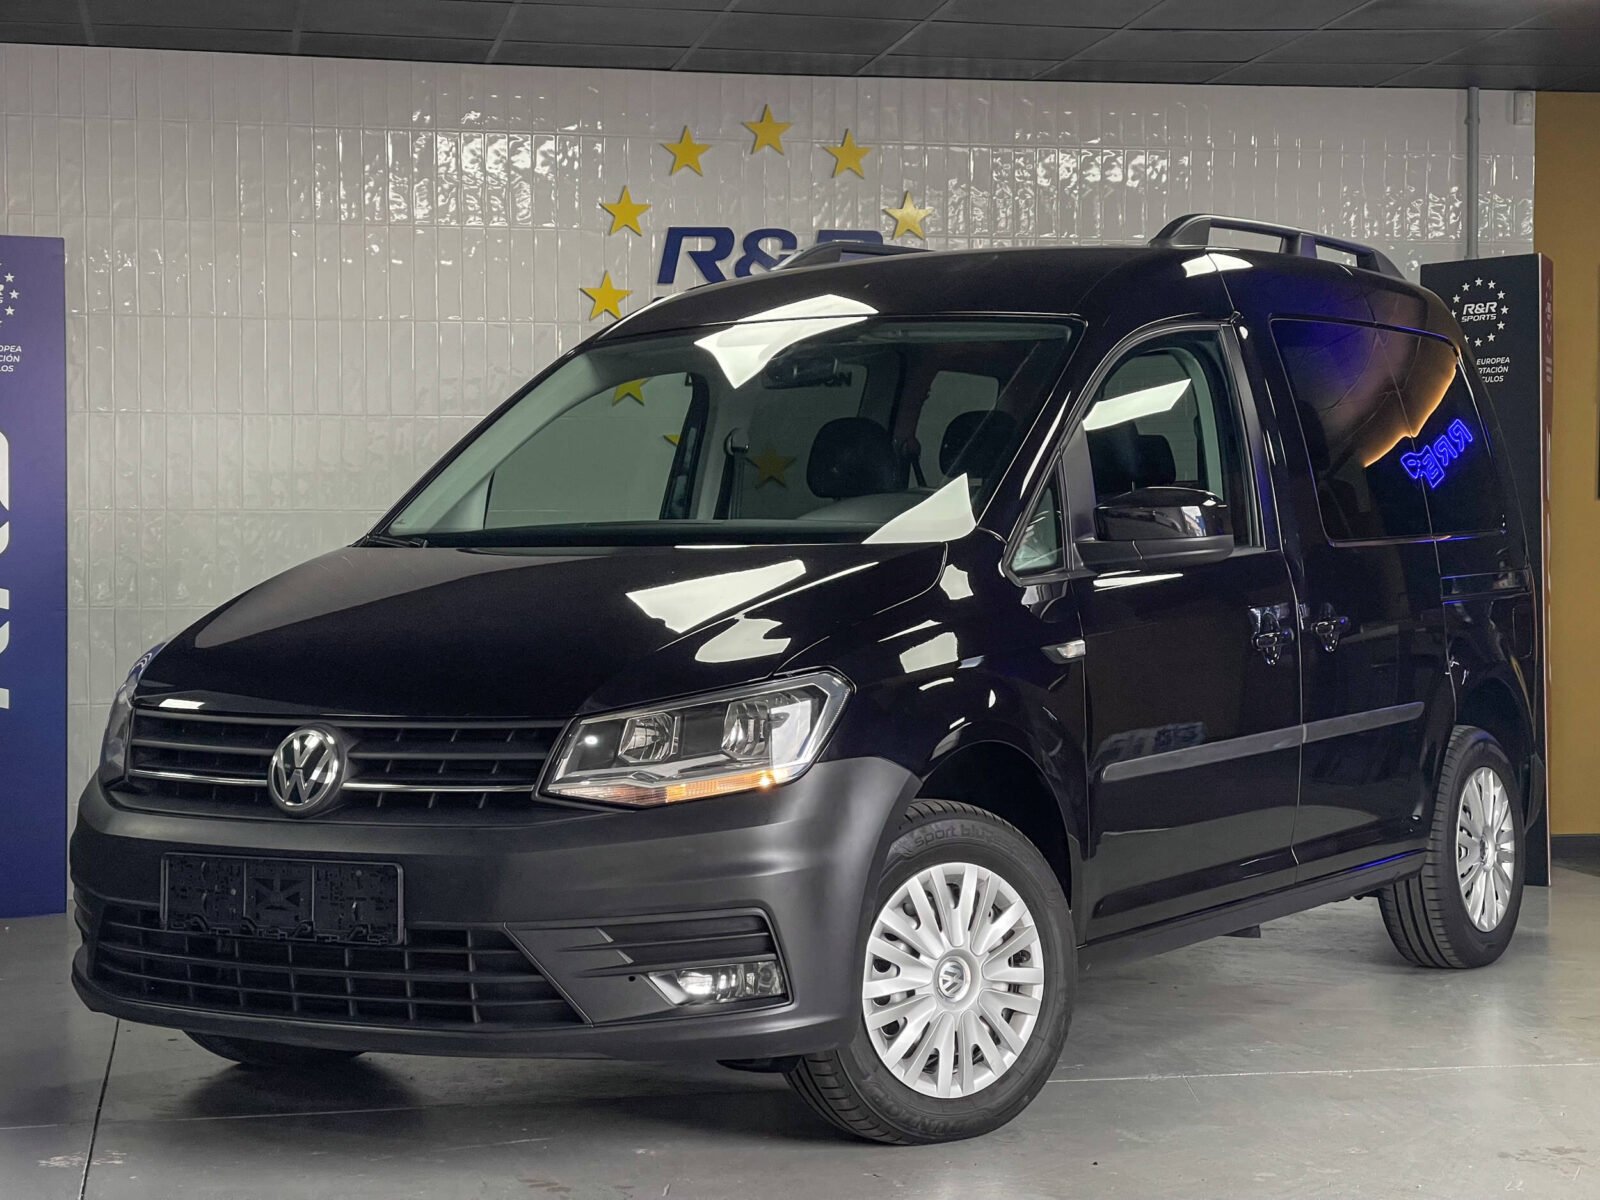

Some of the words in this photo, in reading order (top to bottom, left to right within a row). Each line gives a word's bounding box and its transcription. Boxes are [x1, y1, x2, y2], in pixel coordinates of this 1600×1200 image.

[657, 227, 883, 284] R&
[1462, 301, 1498, 315] R&R
[1461, 313, 1497, 323] SPORTS
[1476, 356, 1510, 366] EUROPEA
[914, 826, 957, 848] sport
